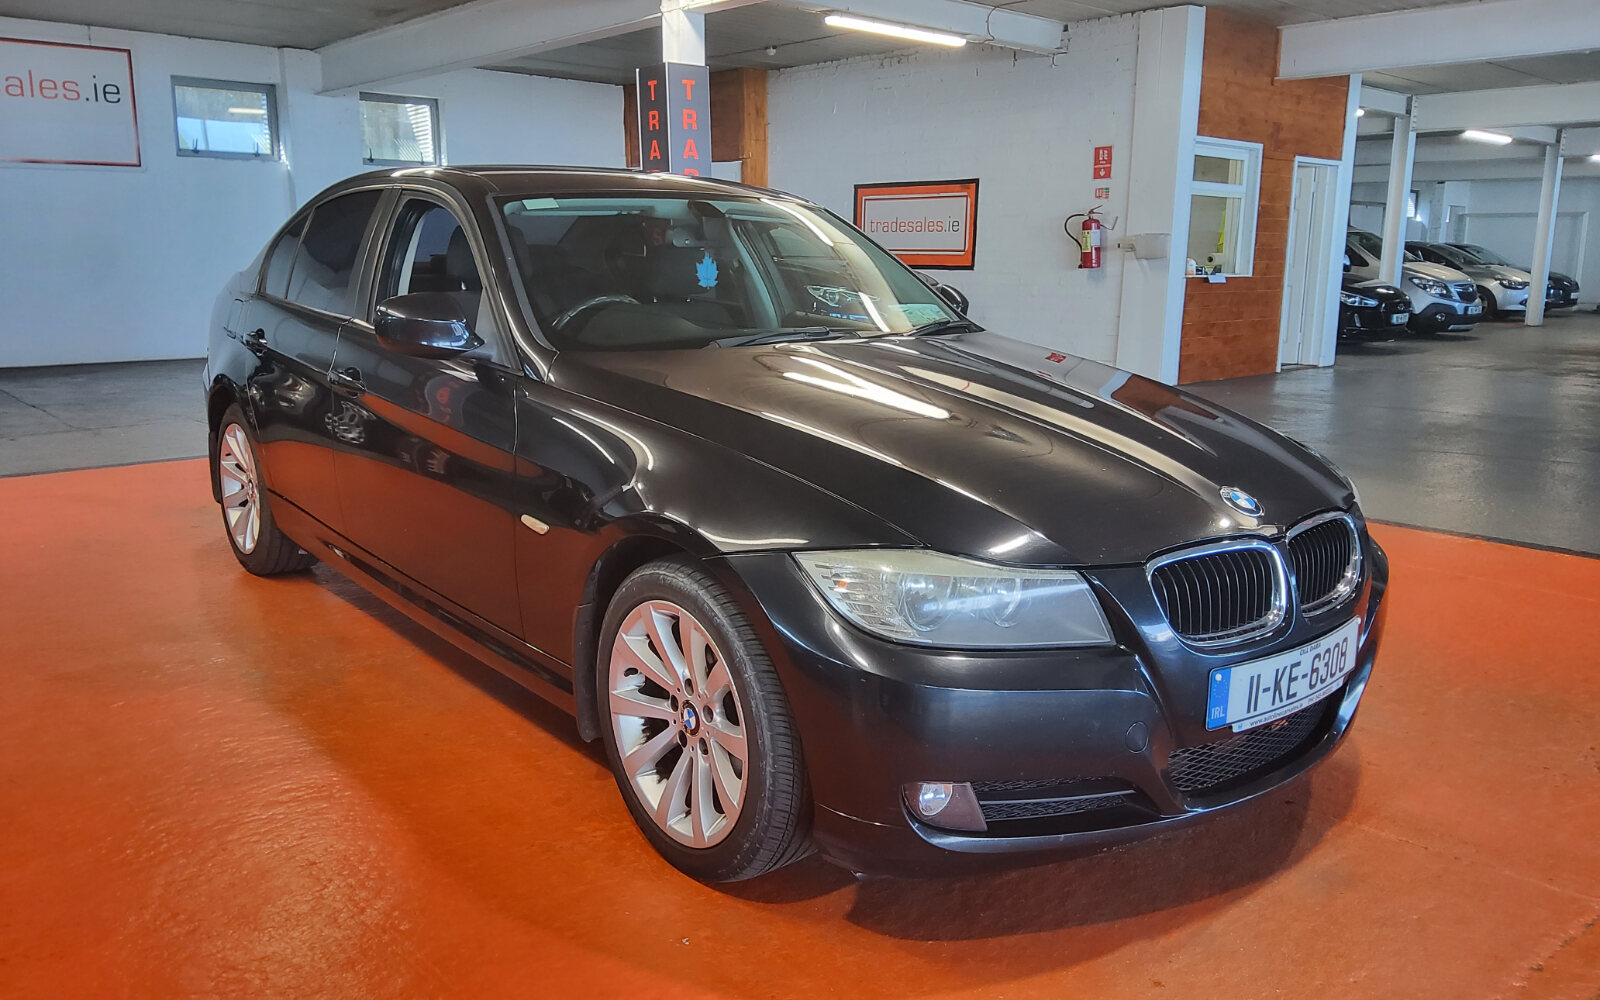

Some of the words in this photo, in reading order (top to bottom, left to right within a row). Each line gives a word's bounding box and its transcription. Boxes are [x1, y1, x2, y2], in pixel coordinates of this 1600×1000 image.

[0, 69, 121, 104] ales.ie
[647, 79, 661, 172] TRA
[869, 215, 960, 233] tradesales.ie
[1246, 637, 1348, 714] 11-KE-6308
[1211, 705, 1225, 720] IRL
